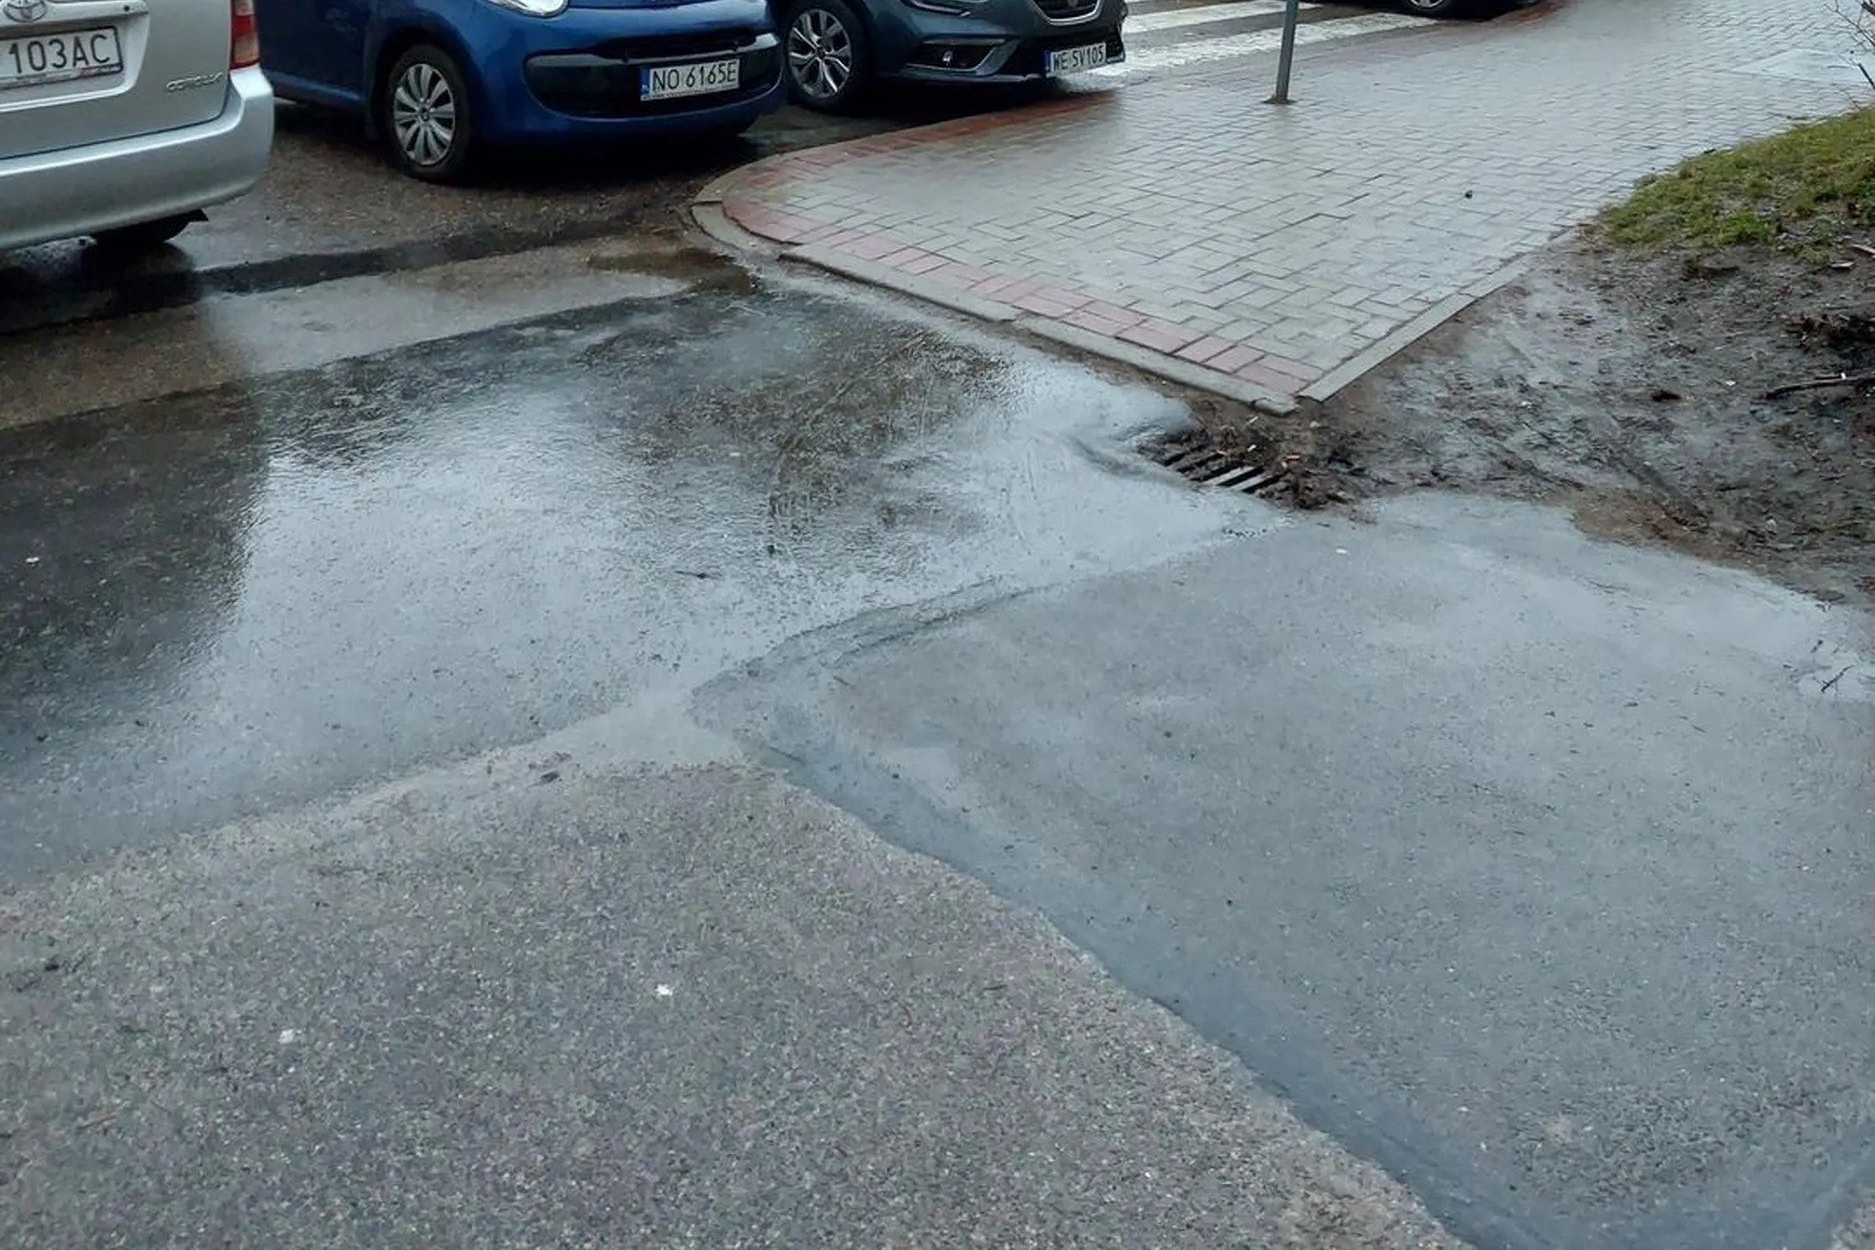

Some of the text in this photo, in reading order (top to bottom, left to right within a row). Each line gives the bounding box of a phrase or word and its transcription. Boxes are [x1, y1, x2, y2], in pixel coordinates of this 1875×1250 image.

[8, 34, 111, 74] 103AC
[652, 61, 737, 92] NO 6165E
